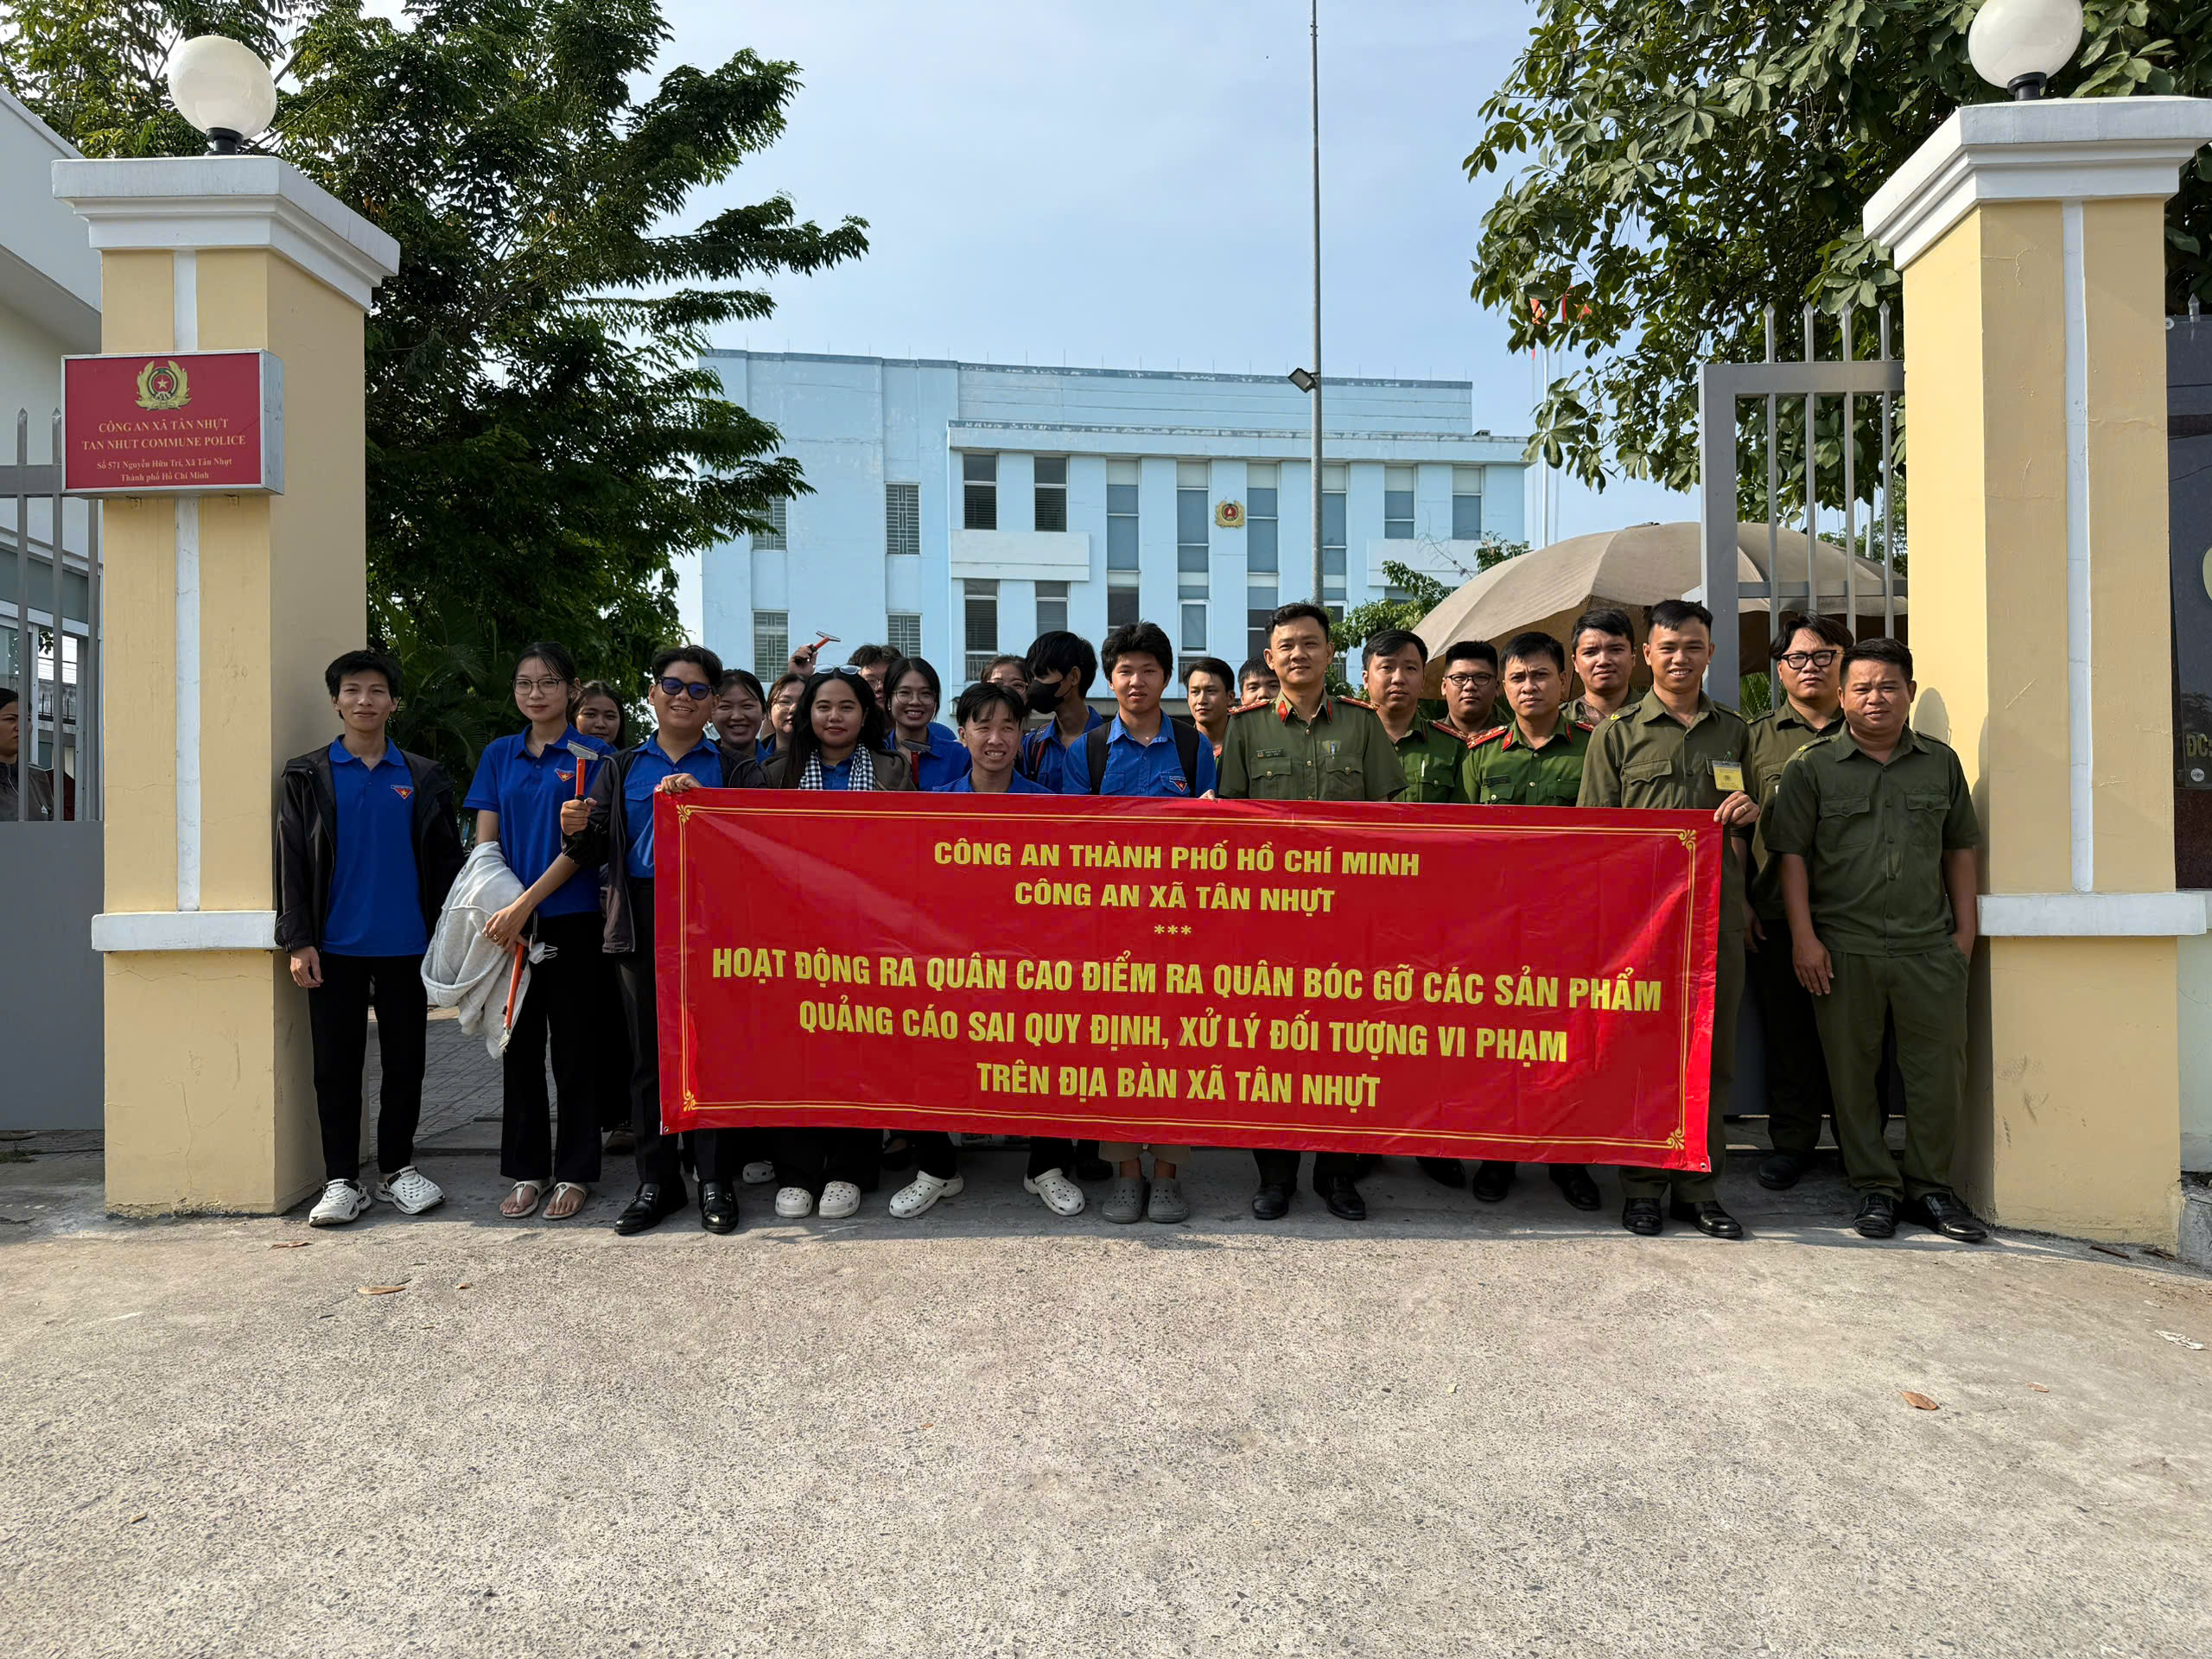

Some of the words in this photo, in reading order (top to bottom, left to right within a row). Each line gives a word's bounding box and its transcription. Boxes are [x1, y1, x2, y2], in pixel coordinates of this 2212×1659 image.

[81, 441, 104, 450] TAN
[107, 439, 138, 449] NHUT
[141, 436, 201, 448] COMMUNE
[204, 435, 246, 446] POLICE
[99, 420, 131, 433] CÔNG
[134, 422, 149, 431] AN
[152, 418, 168, 430] XÃ
[170, 417, 194, 430] TÂN
[196, 417, 229, 431] NHỰT
[97, 459, 106, 469] Số
[185, 458, 195, 467] Xã
[197, 457, 212, 466] Tân
[120, 473, 144, 482] Thành
[146, 470, 160, 483] phố
[162, 470, 173, 480] Hồ
[174, 471, 188, 480] Chí
[189, 471, 209, 480] Minh
[935, 838, 1011, 865] CÔNG
[1020, 844, 1059, 866] AN
[1070, 841, 1161, 868] THÀNH
[1172, 840, 1228, 870] PHỐ
[1237, 842, 1274, 871] HỒ
[1285, 847, 1332, 873] CHÍ
[1342, 852, 1419, 875] MINH
[1015, 878, 1090, 906] CÔNG
[1101, 885, 1139, 906] AN
[1149, 882, 1186, 908] XÃ
[1196, 882, 1249, 909] TÂN
[1261, 887, 1335, 917] NHỰT
[713, 948, 786, 983] HOẠT
[795, 947, 870, 988] ĐỘNG
[880, 957, 916, 987] RA
[927, 952, 1006, 991] QUÂN
[1017, 960, 1072, 990] CAO
[1082, 950, 1155, 993] ĐIỂM
[1166, 964, 1203, 994] RA
[1214, 960, 1293, 998] QUÂN
[1304, 963, 1362, 999] BÓC
[1374, 964, 1414, 1001] GỠ
[1424, 967, 1484, 1004] CÁC
[1495, 966, 1558, 1007] SẢN
[1569, 967, 1661, 1011] PHẨM
[800, 995, 893, 1034] QUẢNG
[903, 1004, 957, 1039] CÁO
[969, 1012, 1014, 1042] SAI
[1026, 1013, 1081, 1046] QUY
[1090, 1014, 1168, 1051] ĐỊNH,
[1179, 1007, 1221, 1047] XỬ
[1228, 1013, 1261, 1048] LÝ
[1270, 1010, 1319, 1051] ĐỐI
[1329, 1020, 1427, 1060] TƯỢNG
[1438, 1027, 1465, 1057] VI
[1477, 1028, 1567, 1067] PHẠM
[977, 1059, 1049, 1094] TRÊN
[1058, 1067, 1107, 1102] ĐỊA
[1118, 1062, 1176, 1098] BÀN
[1187, 1065, 1225, 1100] XÃ
[1236, 1066, 1292, 1103] TÂN
[1302, 1074, 1380, 1113] NHỰT
